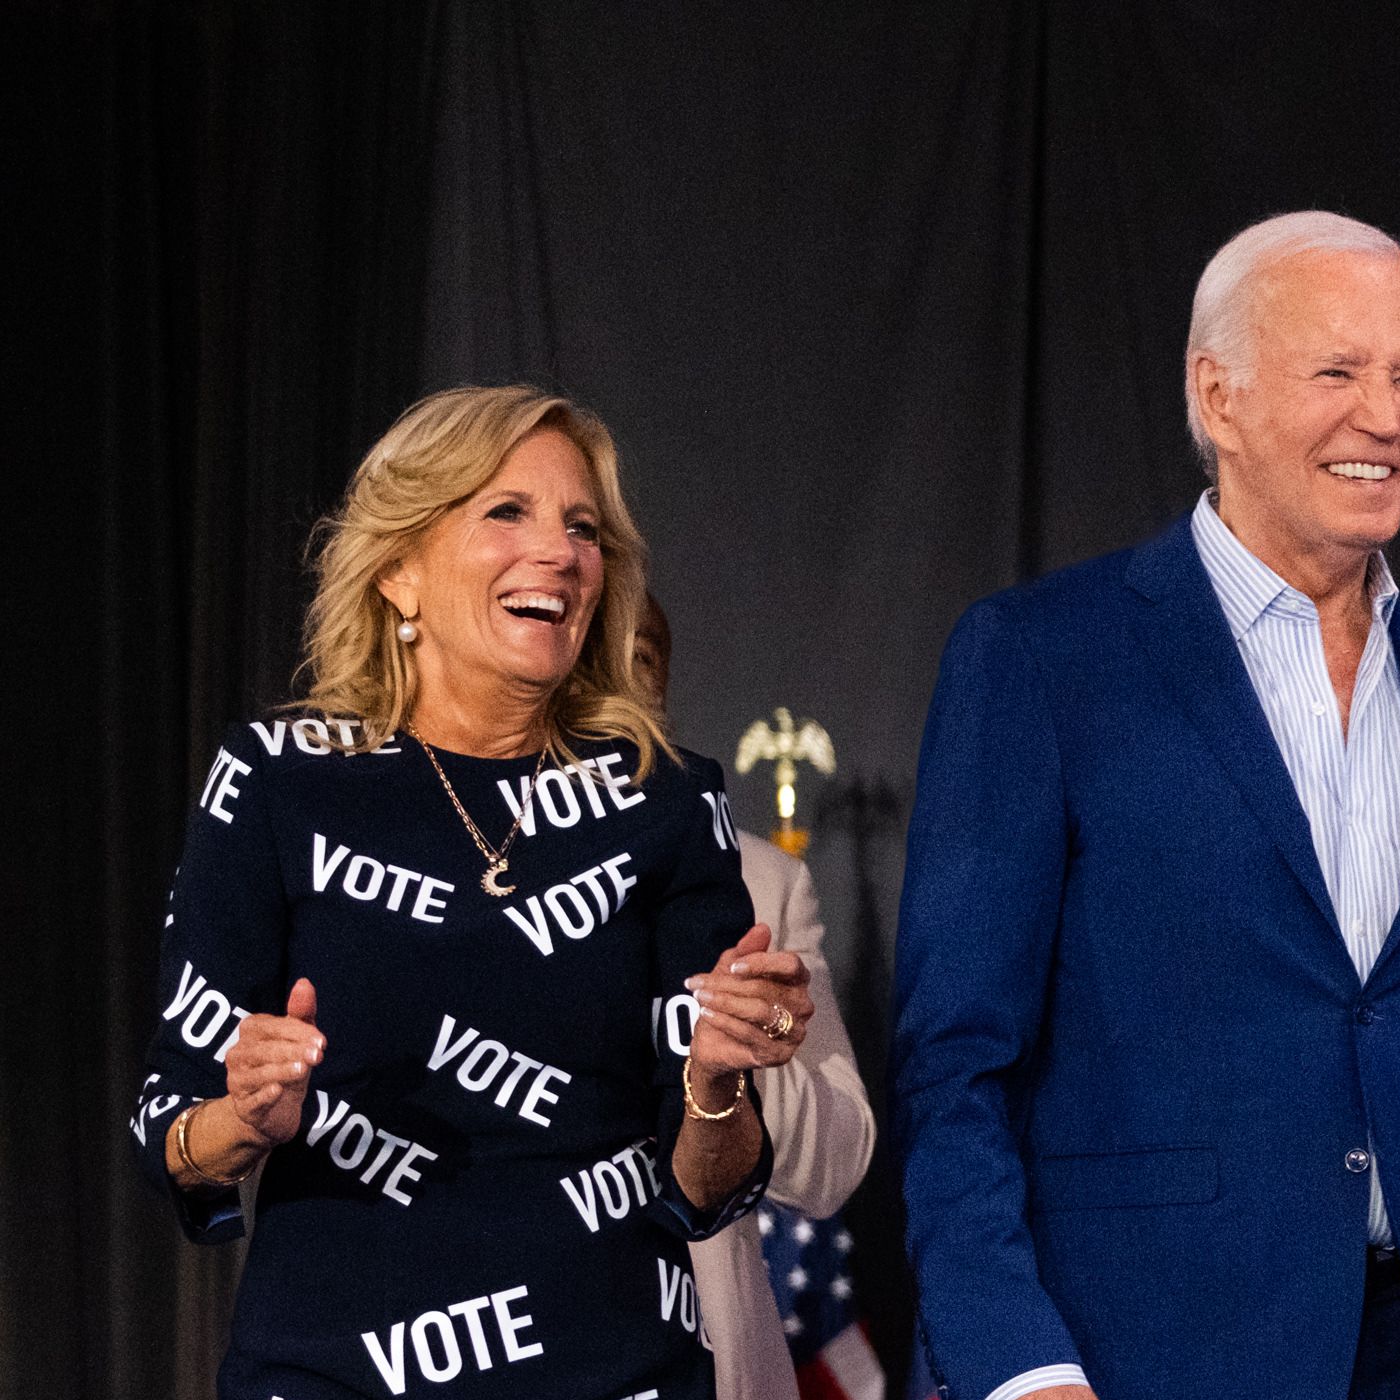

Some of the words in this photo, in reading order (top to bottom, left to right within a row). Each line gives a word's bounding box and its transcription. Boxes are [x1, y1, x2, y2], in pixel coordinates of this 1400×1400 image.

[497, 753, 648, 837] VOTE
[311, 832, 456, 925] VOTE
[503, 852, 639, 957] VOTE
[426, 1014, 572, 1128] VOTE
[305, 1090, 439, 1207] VOTE
[560, 1137, 666, 1234] VOTE
[361, 1285, 544, 1396] VOTE
